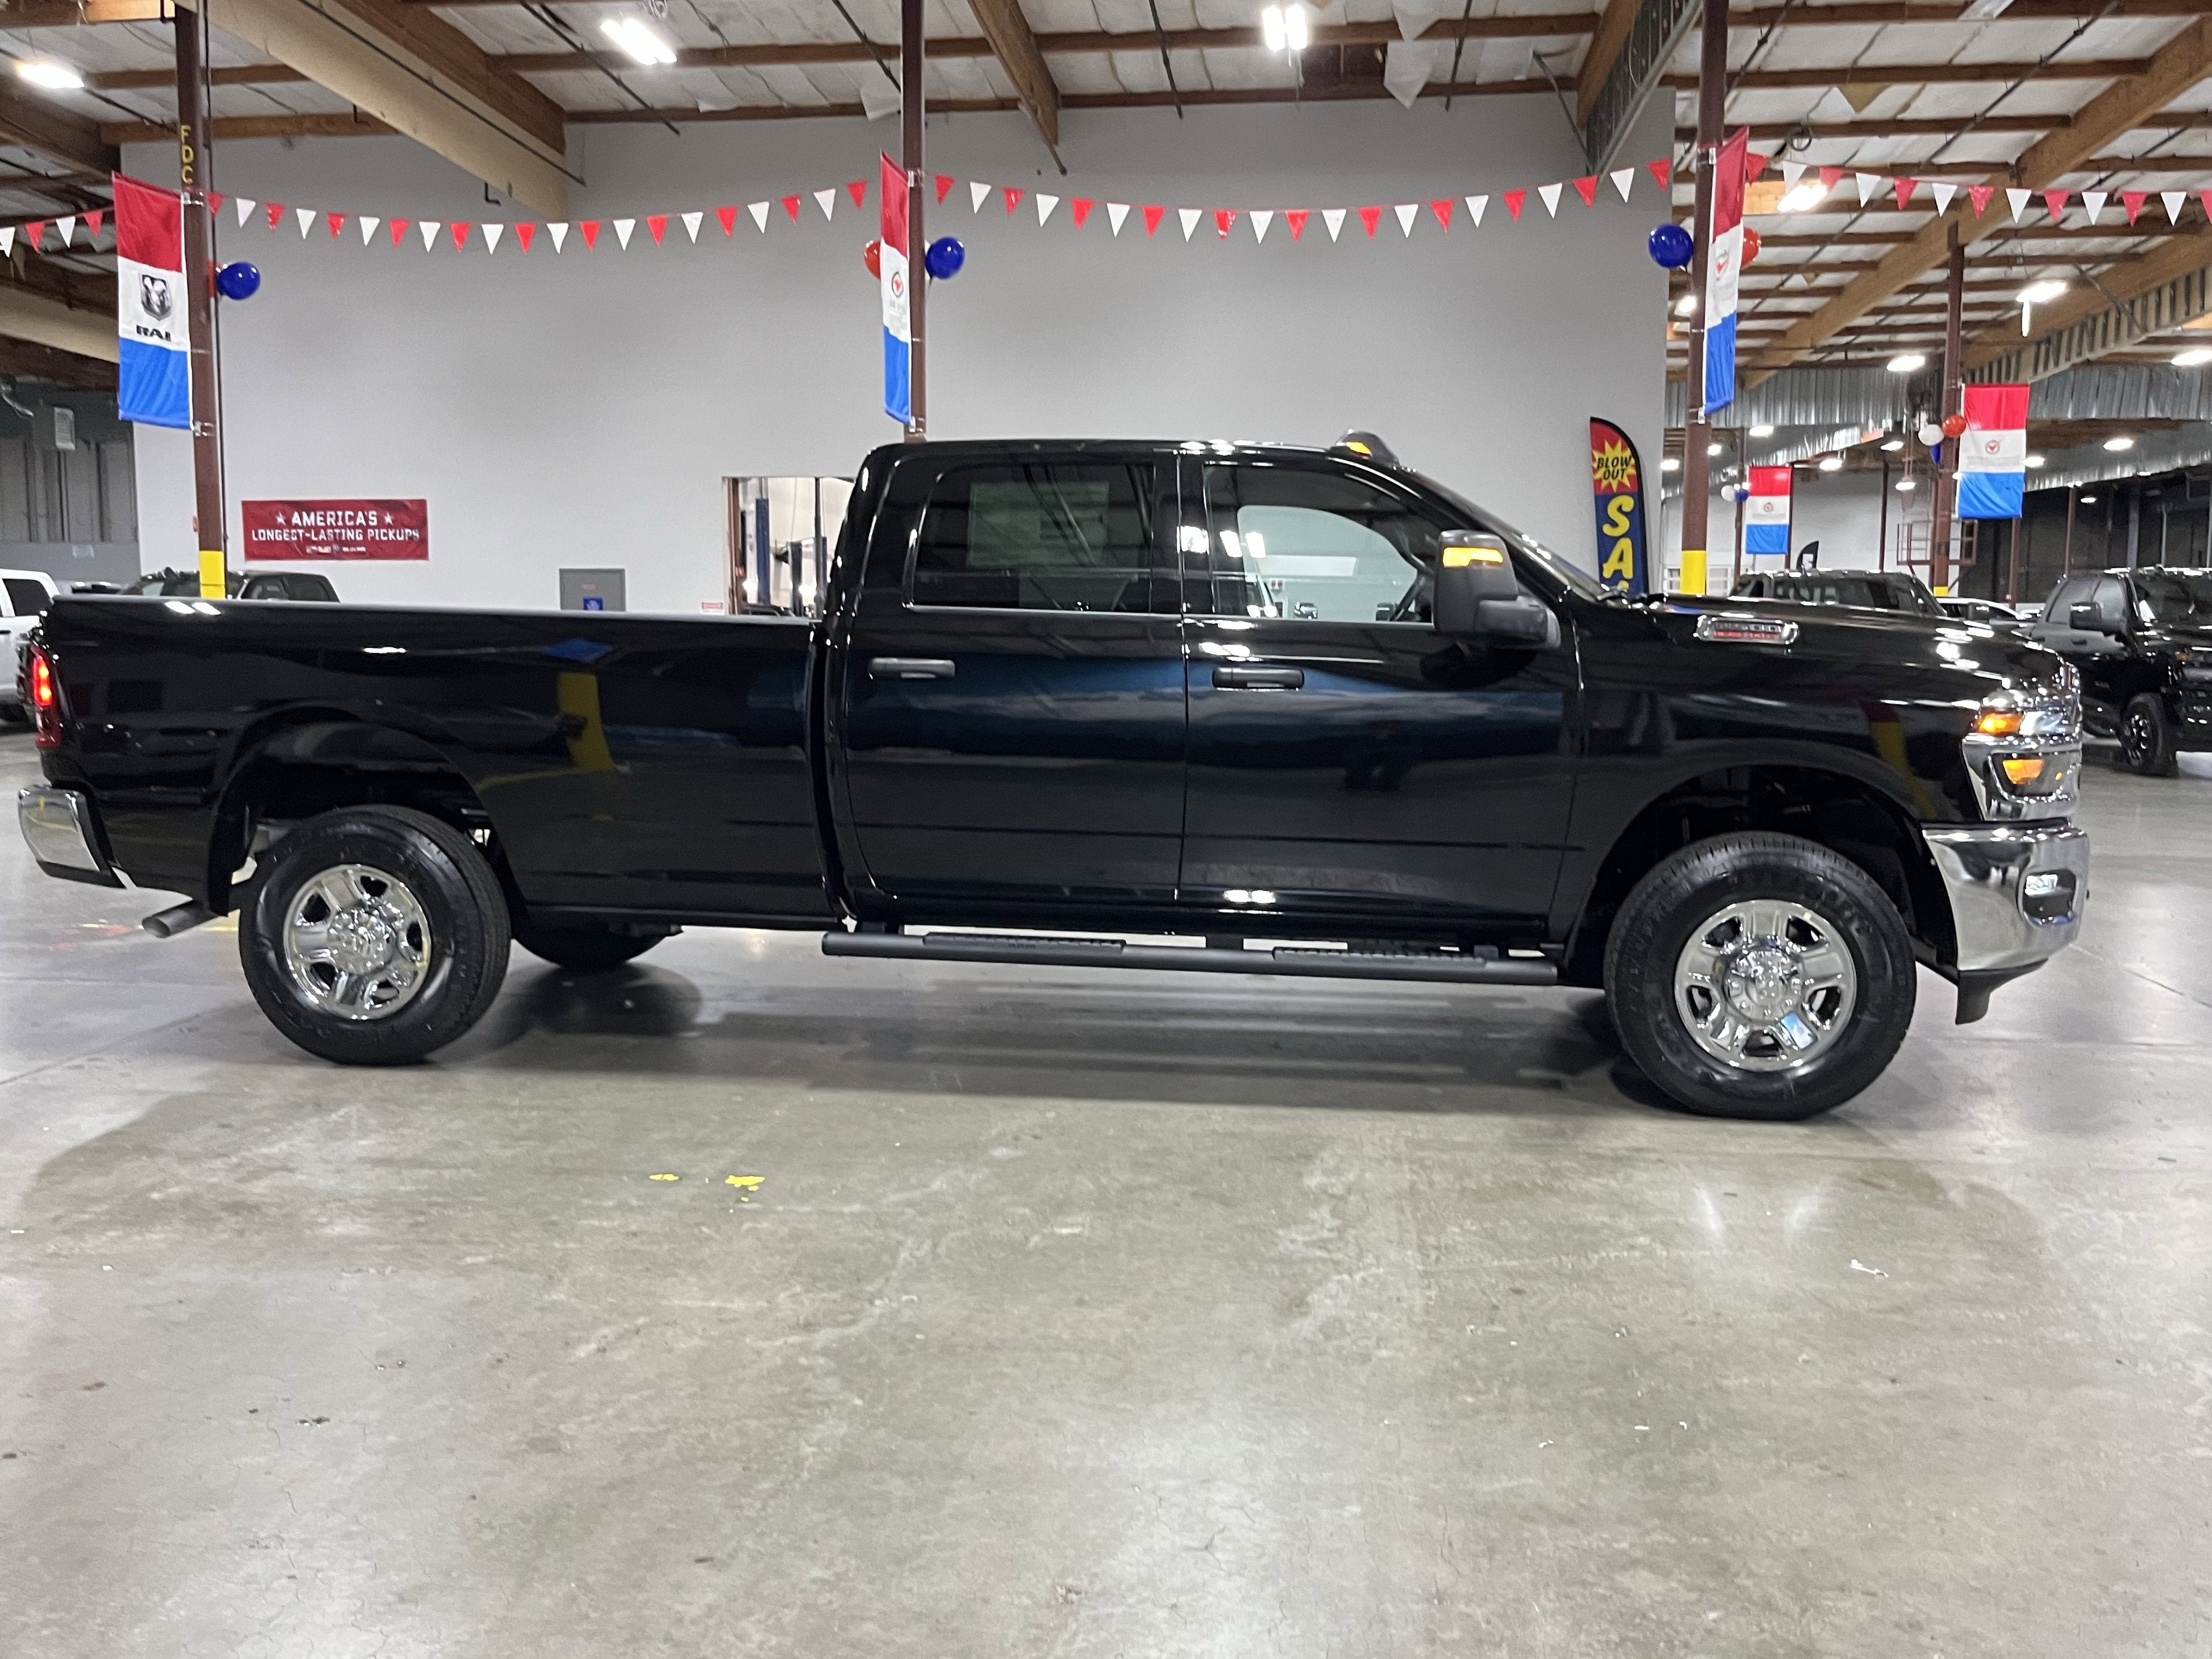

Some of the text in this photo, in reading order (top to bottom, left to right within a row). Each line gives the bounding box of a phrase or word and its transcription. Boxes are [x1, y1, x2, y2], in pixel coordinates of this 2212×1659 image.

[180, 125, 194, 185] FDC
[1596, 455, 1632, 467] BLOW
[1603, 468, 1627, 481] OUT
[291, 511, 377, 526] AMERICA'S
[252, 528, 420, 541] LONGEST-LASTING PICKUPS
[1602, 494, 1634, 592] SA
